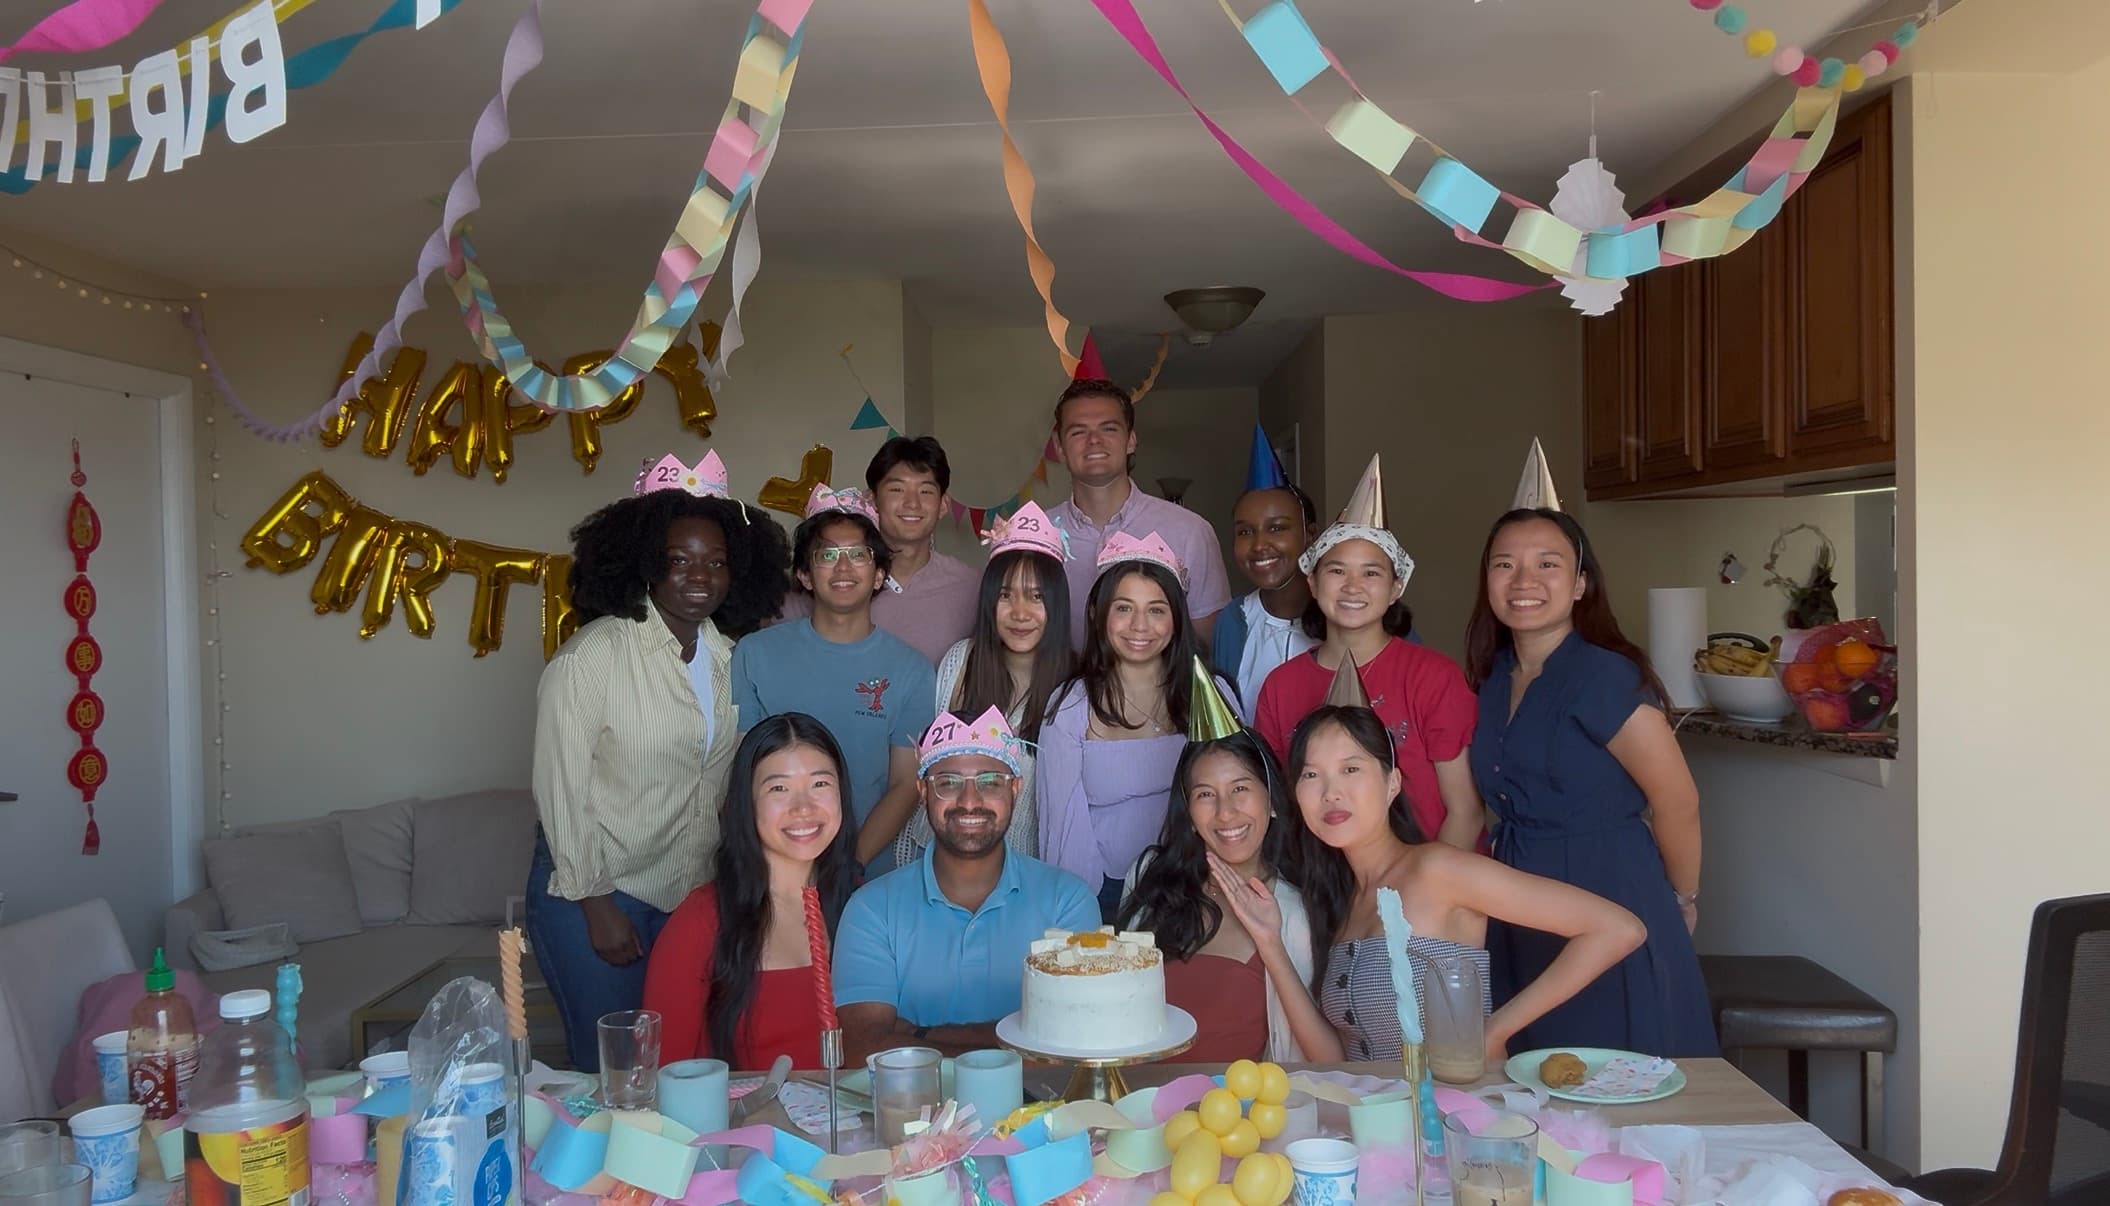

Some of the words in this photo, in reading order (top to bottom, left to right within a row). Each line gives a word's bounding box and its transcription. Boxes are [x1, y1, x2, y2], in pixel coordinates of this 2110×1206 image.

[320, 320, 723, 484] HAPPY
[657, 466, 680, 482] 23
[1017, 516, 1040, 532] 23
[931, 722, 956, 746] 27
